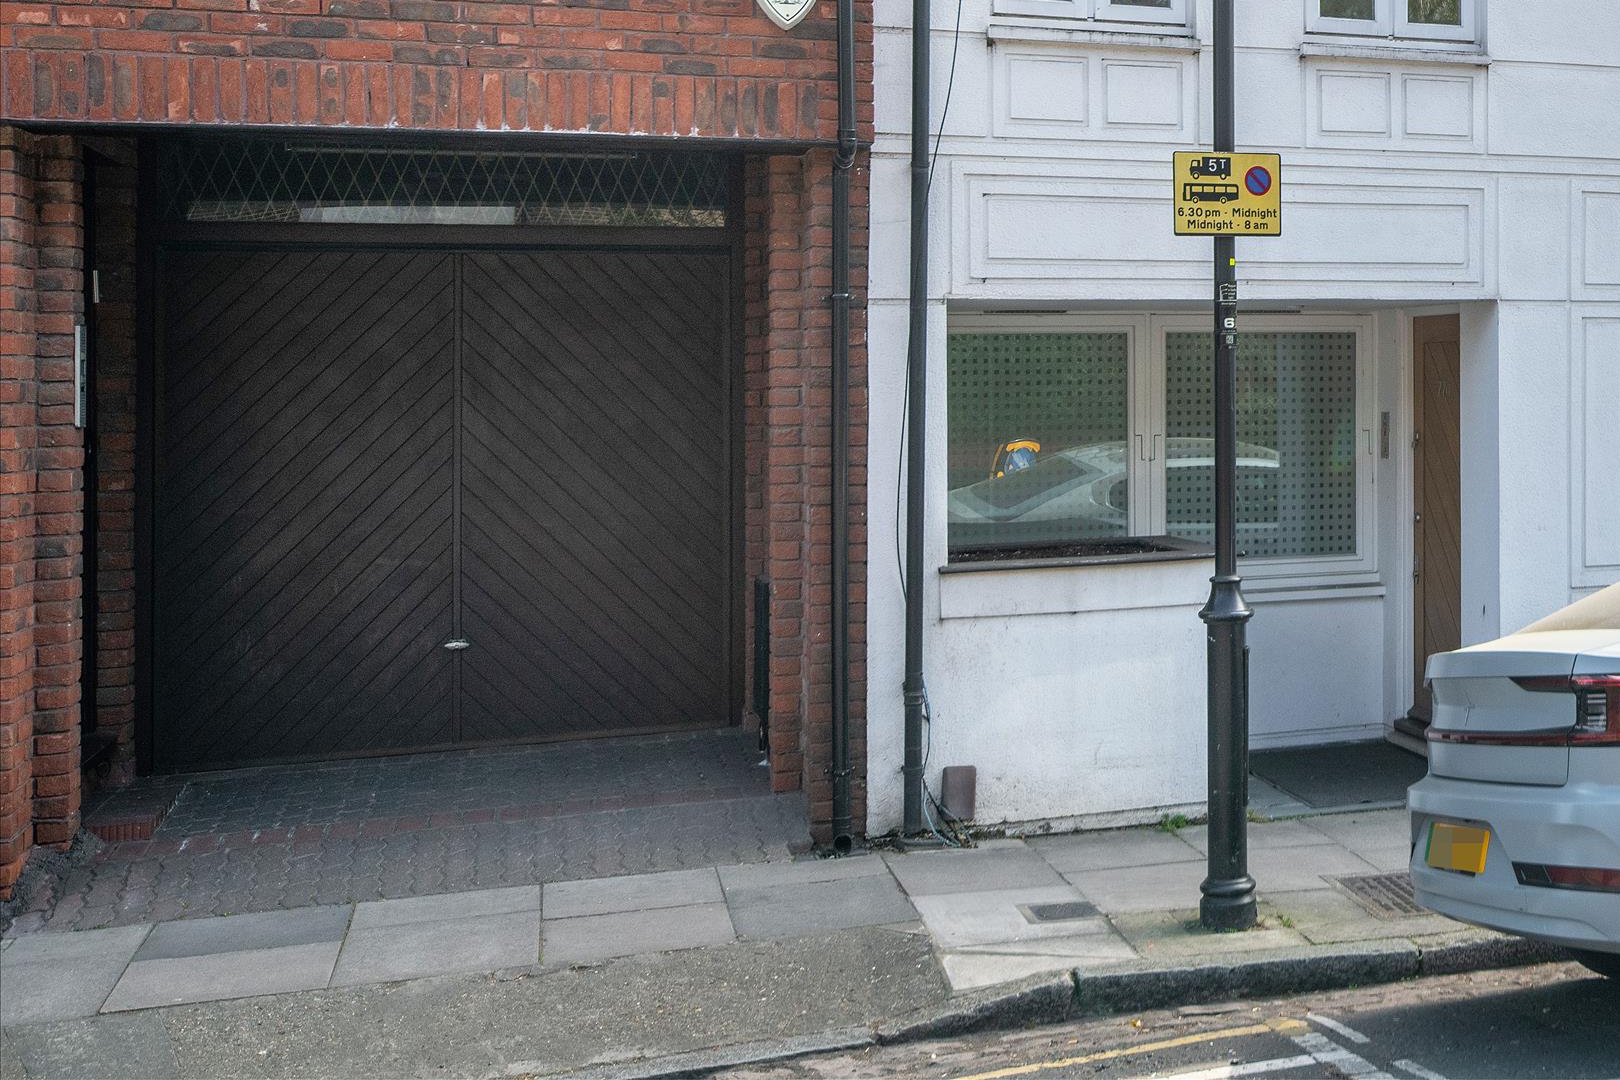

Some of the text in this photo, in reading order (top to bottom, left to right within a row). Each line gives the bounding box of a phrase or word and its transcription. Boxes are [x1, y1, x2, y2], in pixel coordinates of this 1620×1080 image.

[1178, 207, 1203, 217] 6.30
[1205, 210, 1221, 218] pm
[1232, 208, 1277, 219] Midnight
[1187, 219, 1233, 231] Midnight
[1244, 220, 1251, 229] 8
[1224, 318, 1235, 328] 6
